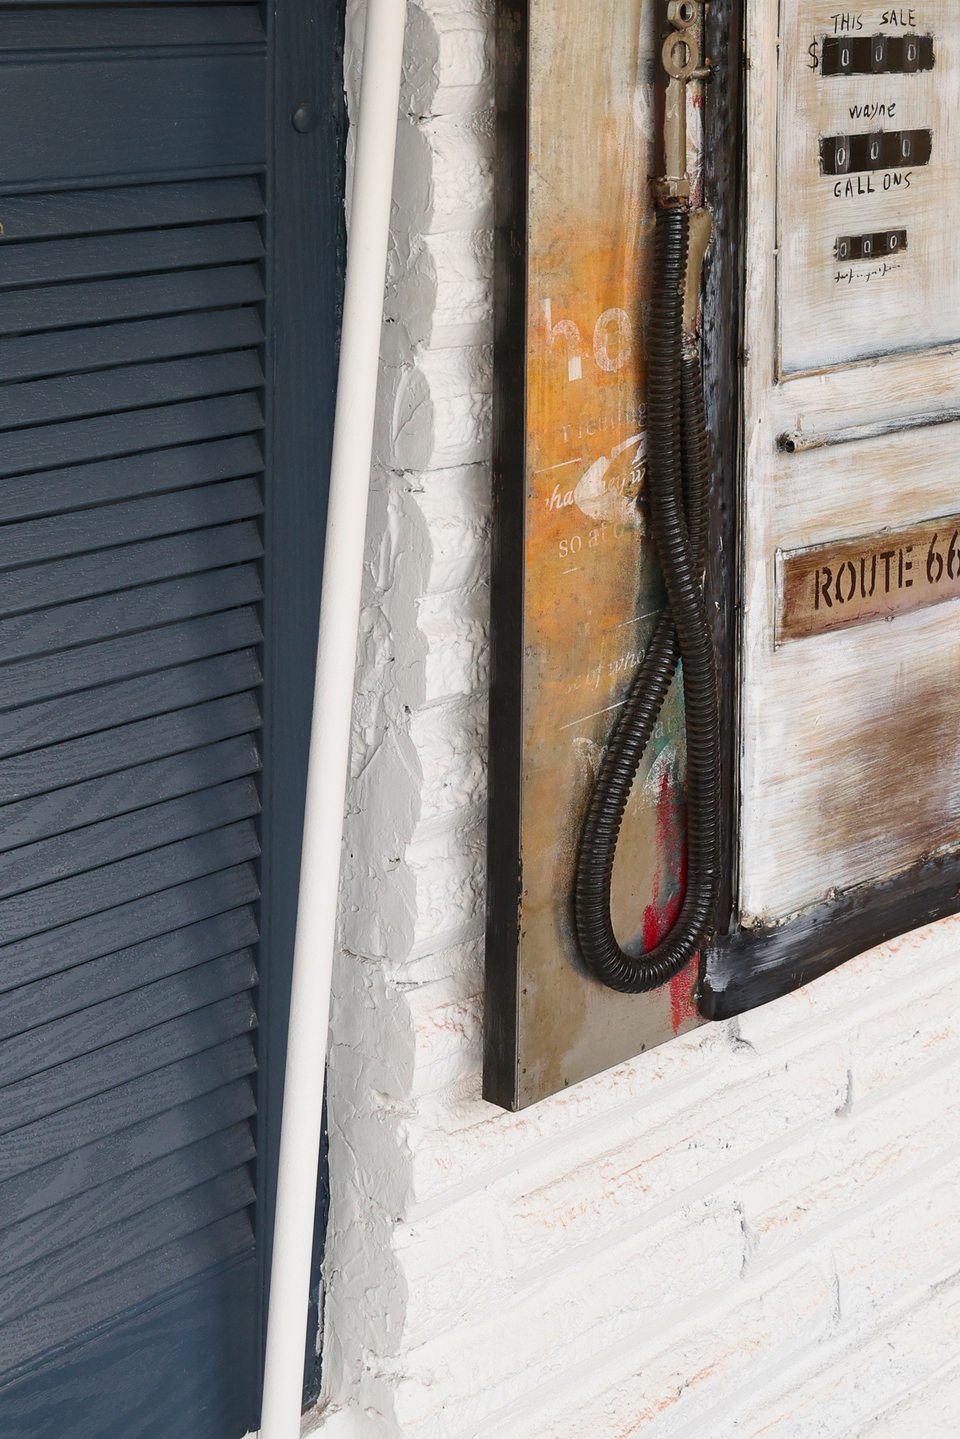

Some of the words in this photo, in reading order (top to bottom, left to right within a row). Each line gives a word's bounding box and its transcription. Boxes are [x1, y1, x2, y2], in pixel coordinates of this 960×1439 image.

[830, 12, 863, 34] THIS
[879, 9, 917, 28] SALE
[848, 102, 897, 124] wayne
[814, 546, 914, 610] ROUTE
